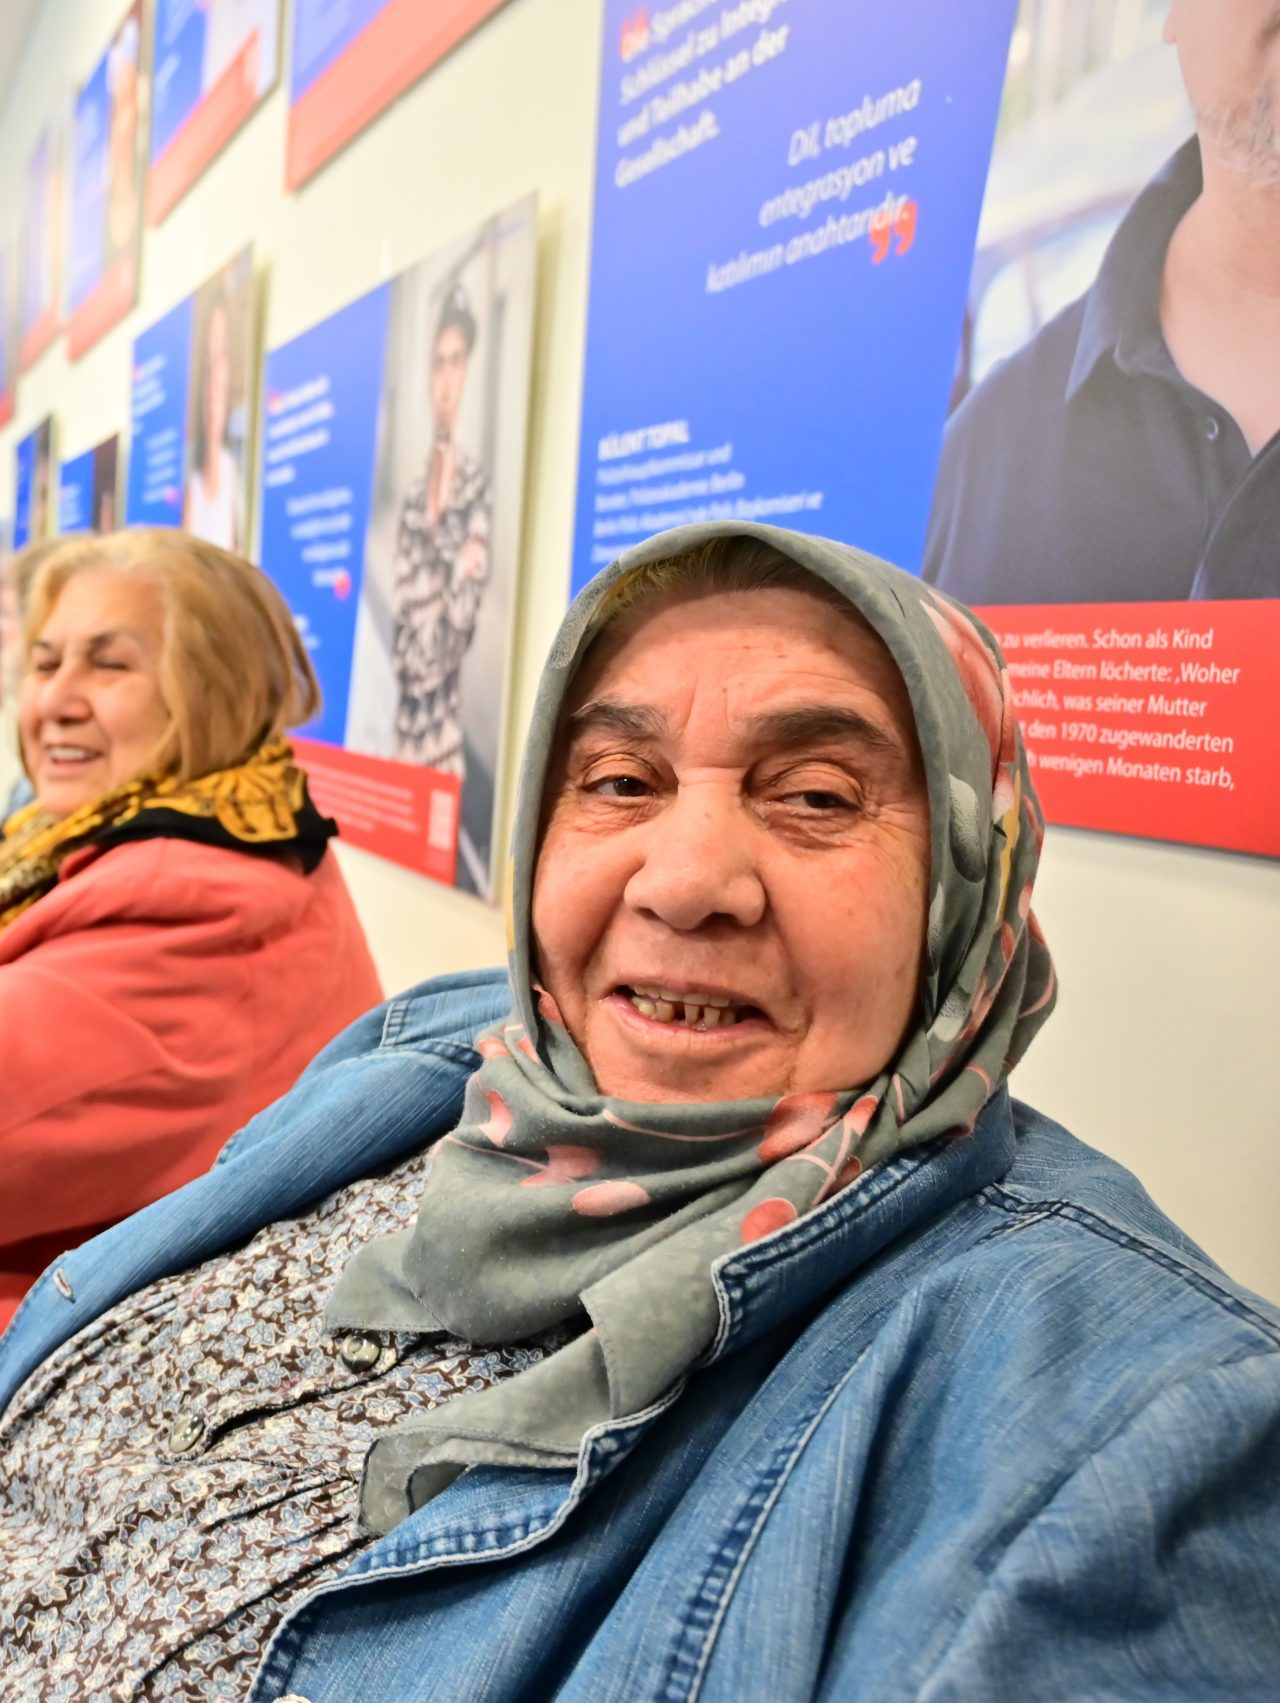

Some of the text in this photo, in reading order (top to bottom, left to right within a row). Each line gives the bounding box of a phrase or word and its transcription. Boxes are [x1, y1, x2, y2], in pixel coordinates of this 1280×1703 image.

[618, 105, 650, 147] und
[723, 50, 750, 83] an
[751, 24, 789, 66] der
[824, 79, 921, 148] topluma
[758, 135, 918, 227] entegrasyon ve
[1003, 633, 1019, 648] zu
[1023, 629, 1088, 649] verlieren.
[1092, 628, 1141, 649] Schon
[1145, 627, 1168, 649] als
[1172, 628, 1214, 649] Kind
[1053, 659, 1097, 679] Eltern
[1100, 660, 1172, 682] löcherte:
[1063, 695, 1092, 711] was
[1095, 693, 1144, 713] seiner
[1147, 695, 1207, 716] Mutter
[1028, 719, 1057, 738] den
[1061, 722, 1097, 742] 1970
[1099, 728, 1233, 753] zugewanderten
[1039, 752, 1103, 778] wenigen
[1106, 757, 1181, 782] Monaten
[1185, 767, 1235, 790] starb,
